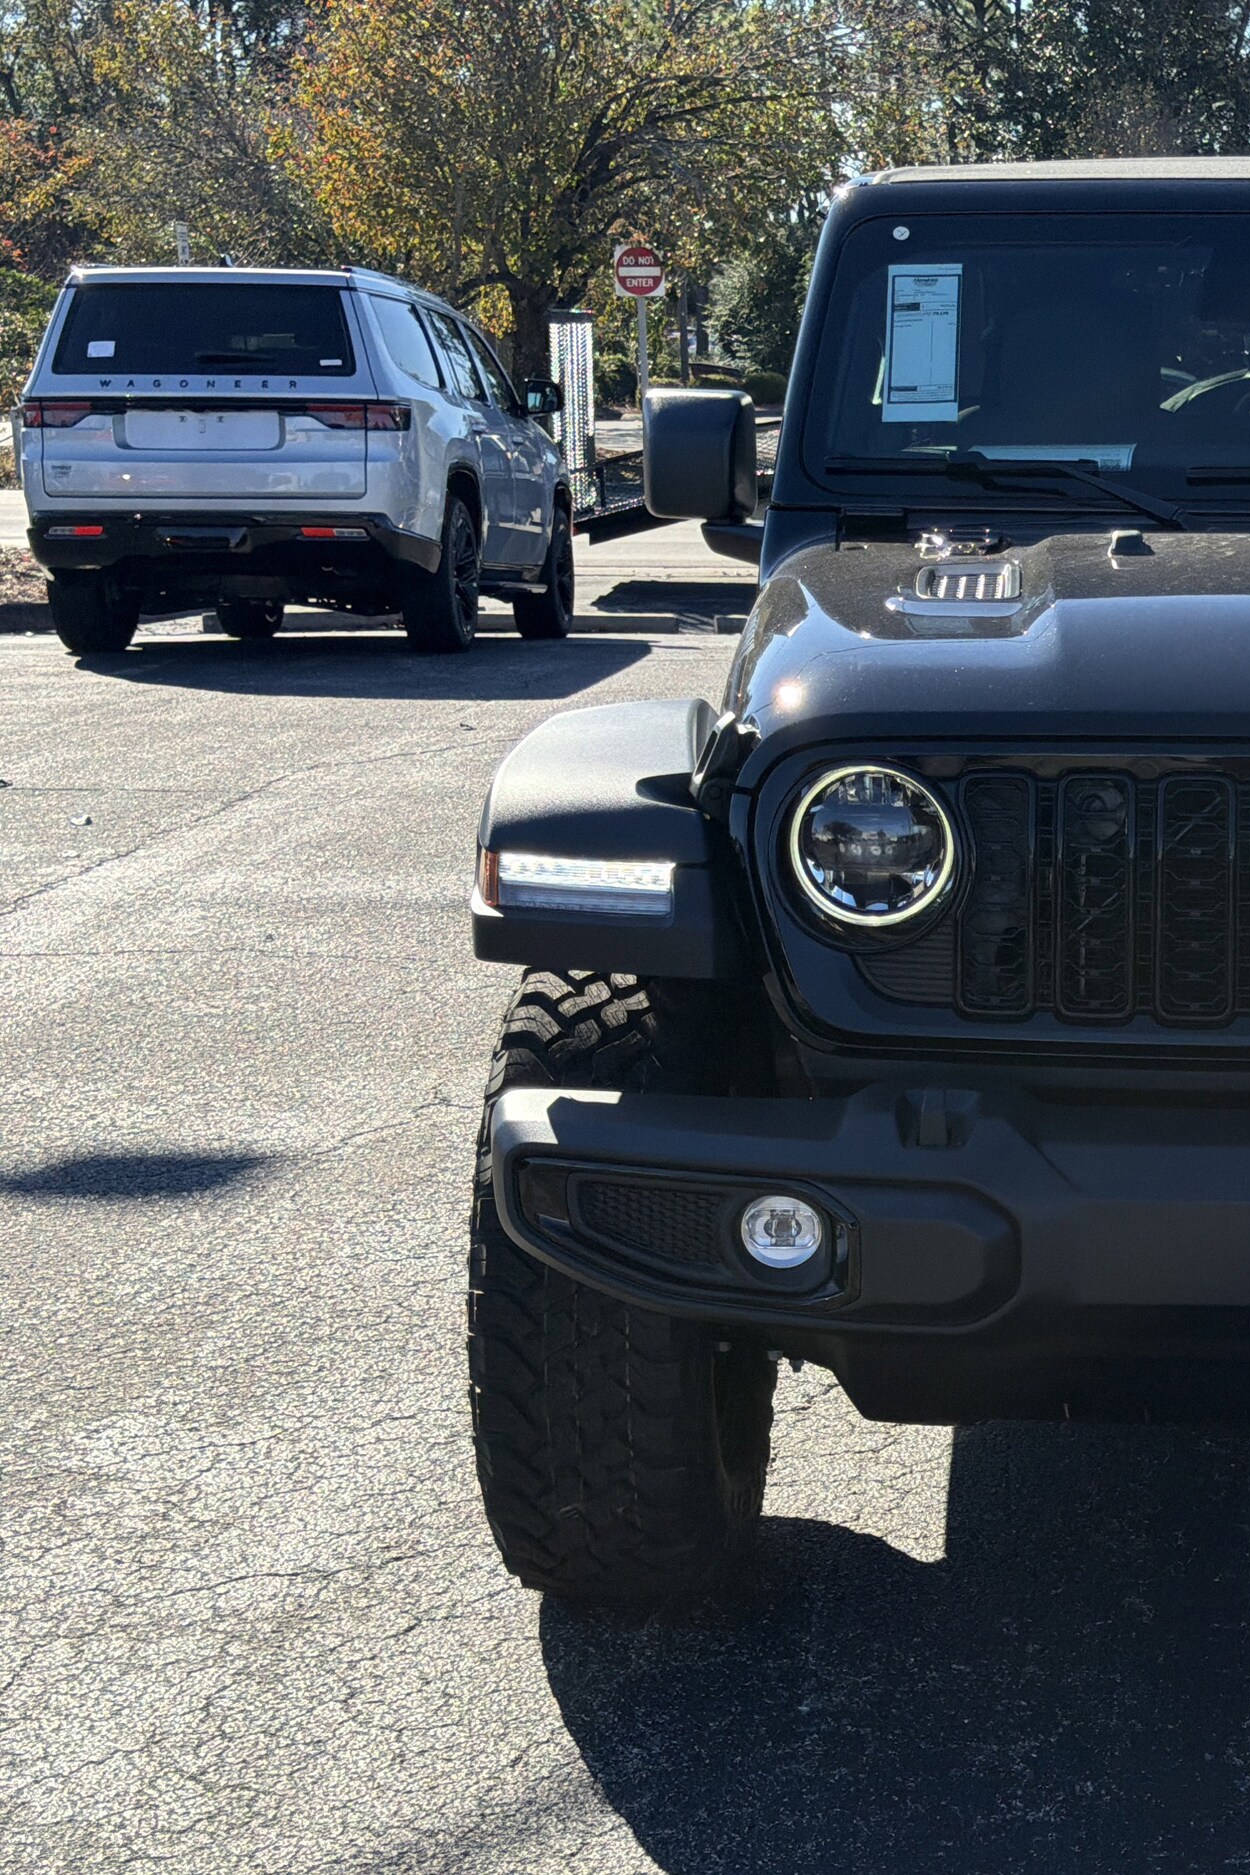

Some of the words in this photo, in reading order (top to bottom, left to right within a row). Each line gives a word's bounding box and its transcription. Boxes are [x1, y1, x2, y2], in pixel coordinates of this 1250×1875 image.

[622, 256, 635, 265] DO
[638, 256, 655, 265] NOT
[626, 278, 654, 287] ENTER
[100, 379, 298, 389] WAGONEER
